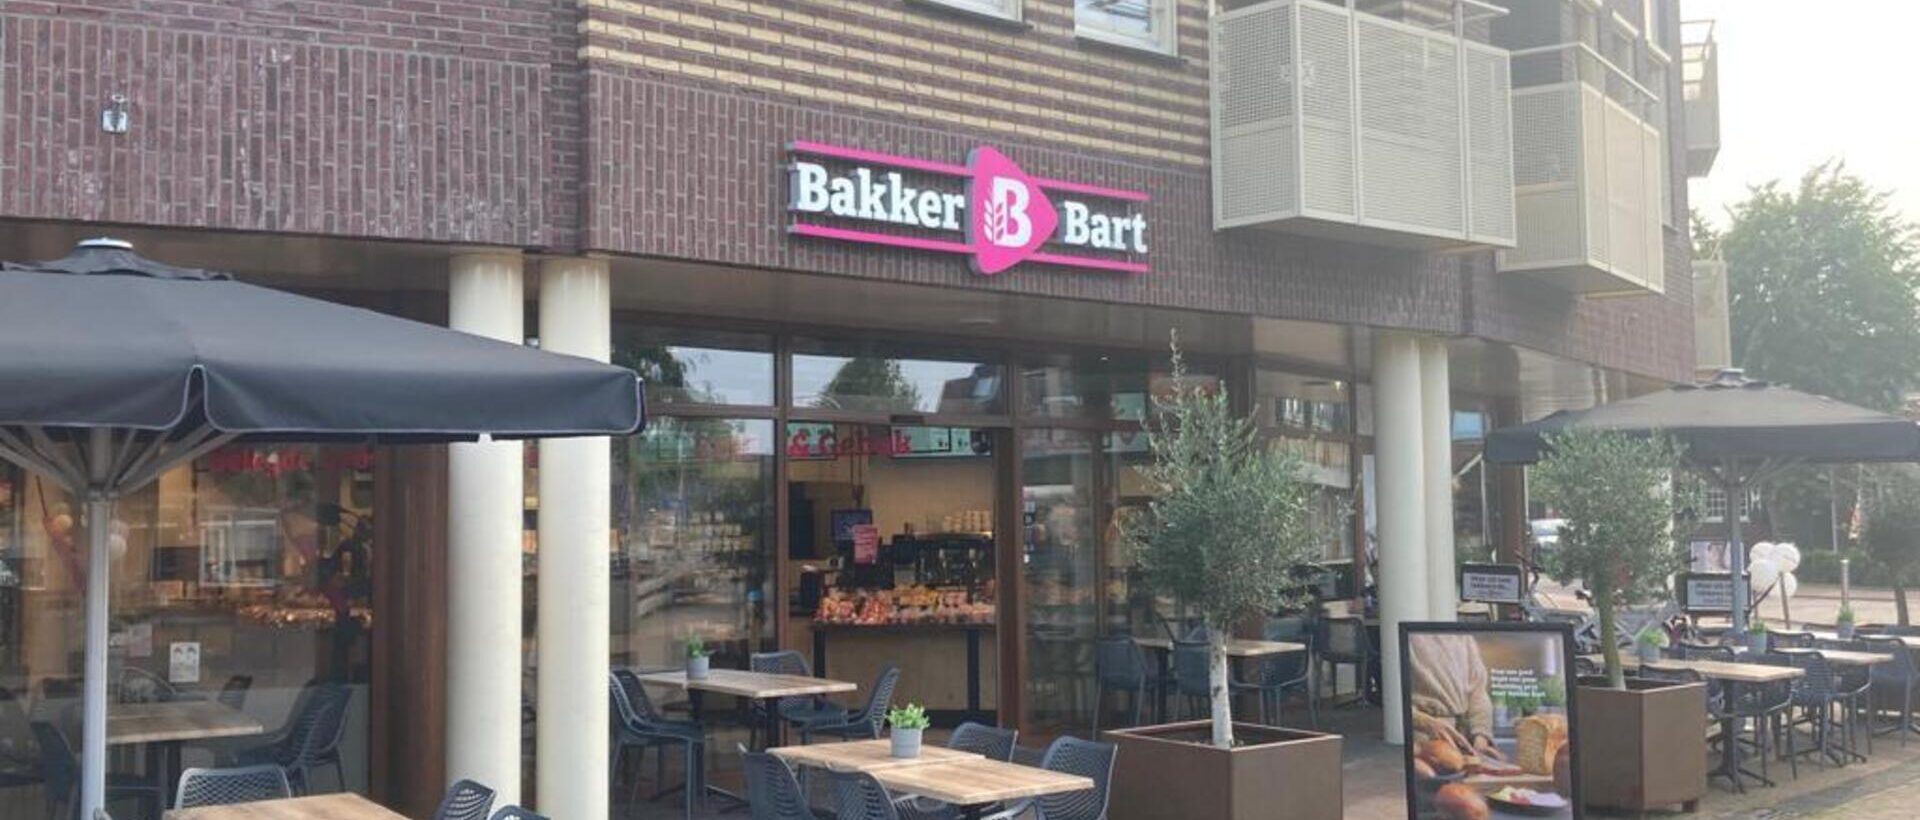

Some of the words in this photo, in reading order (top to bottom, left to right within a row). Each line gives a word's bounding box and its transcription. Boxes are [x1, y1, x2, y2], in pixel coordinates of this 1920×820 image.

[795, 161, 965, 230] Bakker
[992, 177, 1031, 247] B
[1064, 201, 1147, 253] Bart
[788, 431, 810, 457] &
